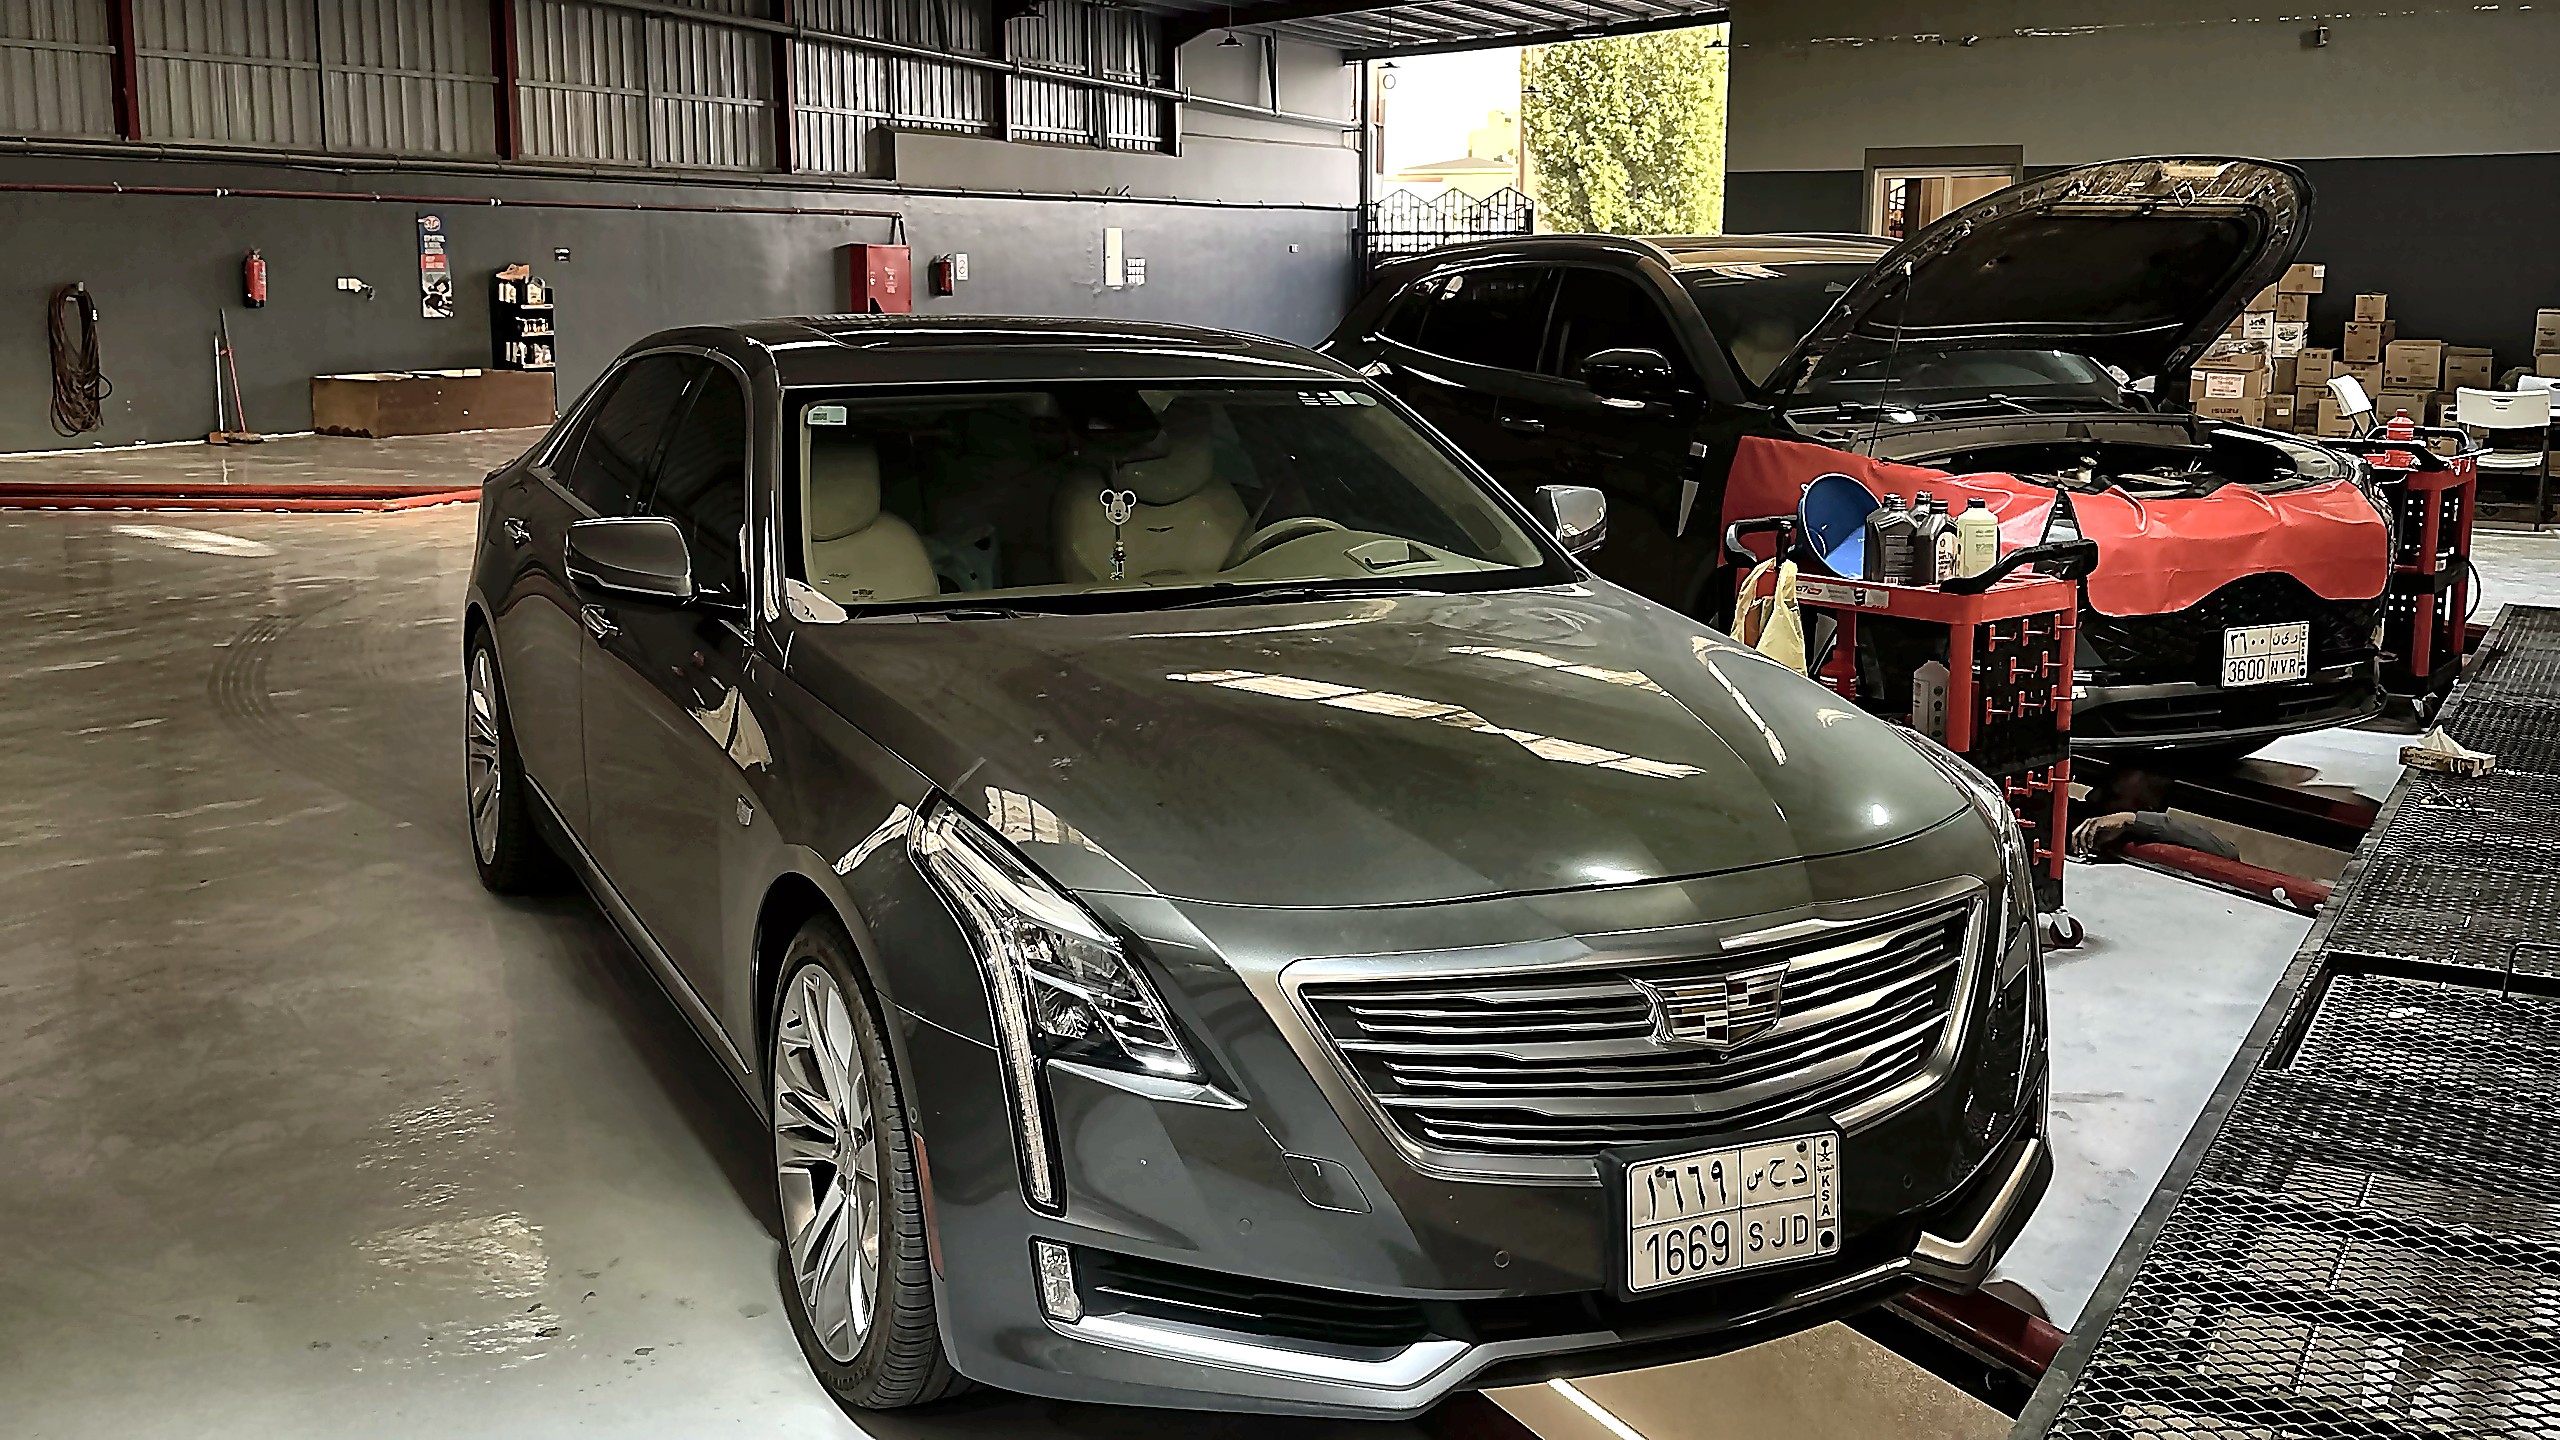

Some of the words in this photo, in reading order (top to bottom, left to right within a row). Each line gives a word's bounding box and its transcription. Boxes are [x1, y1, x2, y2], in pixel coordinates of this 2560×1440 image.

[2227, 658, 2265, 682] 3600
[2270, 658, 2297, 676] NVR
[1645, 1220, 1730, 1280] 1669
[1748, 1214, 1809, 1252] SJD
